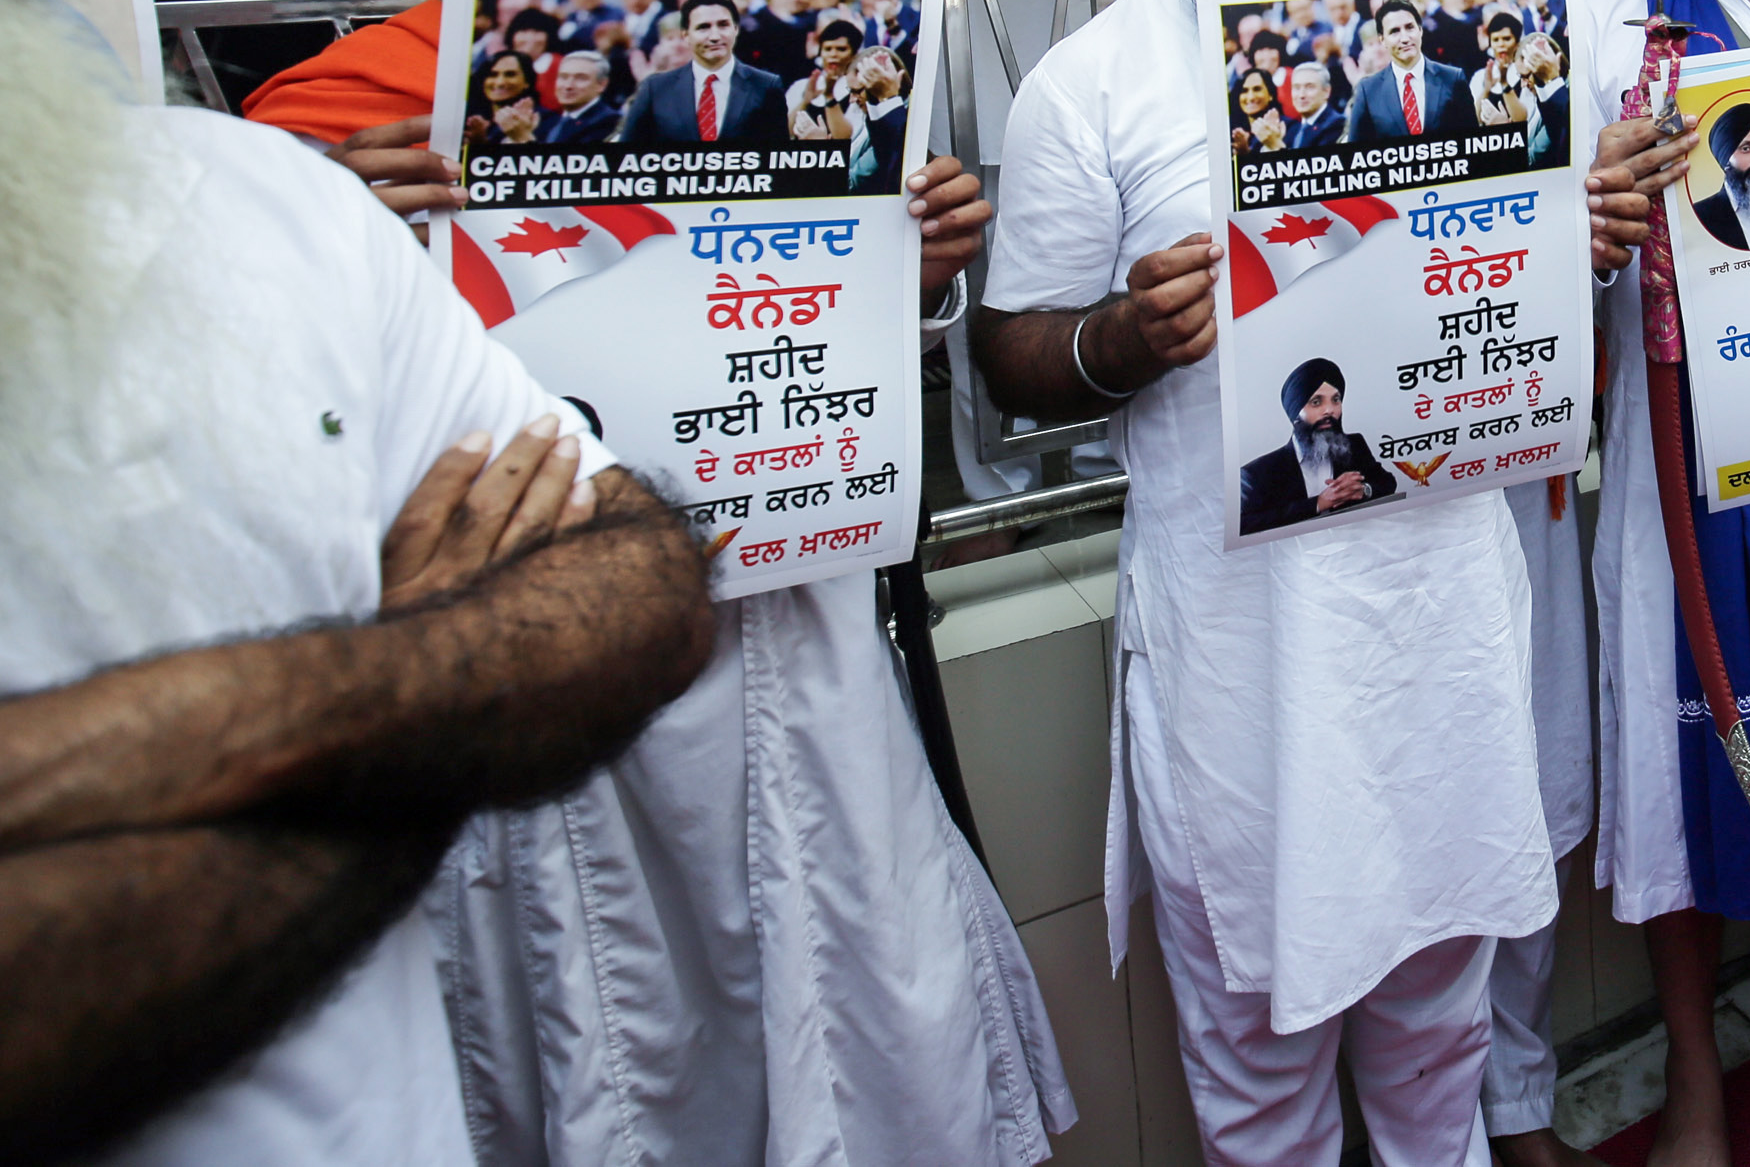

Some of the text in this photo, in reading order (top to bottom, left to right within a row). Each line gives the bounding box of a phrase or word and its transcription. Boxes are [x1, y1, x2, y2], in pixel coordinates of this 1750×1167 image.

[471, 150, 845, 177] CANADA ACCUSES INDIA
[1242, 131, 1525, 181] CANADA ACCUSES INDIA
[470, 174, 771, 201] OF KILLING NIJJAR
[1242, 160, 1469, 204] OF KILLING NIJJAR
[690, 207, 858, 263] ਧੰਨਵਾਦ
[1409, 190, 1538, 240] ਧੰਨਵਾਦ
[1424, 246, 1528, 298] ਕੈਨੇਡਾ
[707, 274, 841, 330] ਕੈਨੇਡਾ
[1439, 298, 1518, 341] ਸ਼ਹੀਦ
[726, 336, 827, 384] ਸ਼ਹੀਦ
[1398, 333, 1558, 390] ਭਾਈ ਨਿੱਝਰ
[674, 381, 877, 443] ਭਾਈ ਨਿੱਝਰ
[1414, 370, 1543, 421] ਦੇ ਕਾਤਲਾਂ ਨੂੰ
[1380, 397, 1573, 459] ਬੇਨਕਾਬ ਕਰਨ ਲਈ
